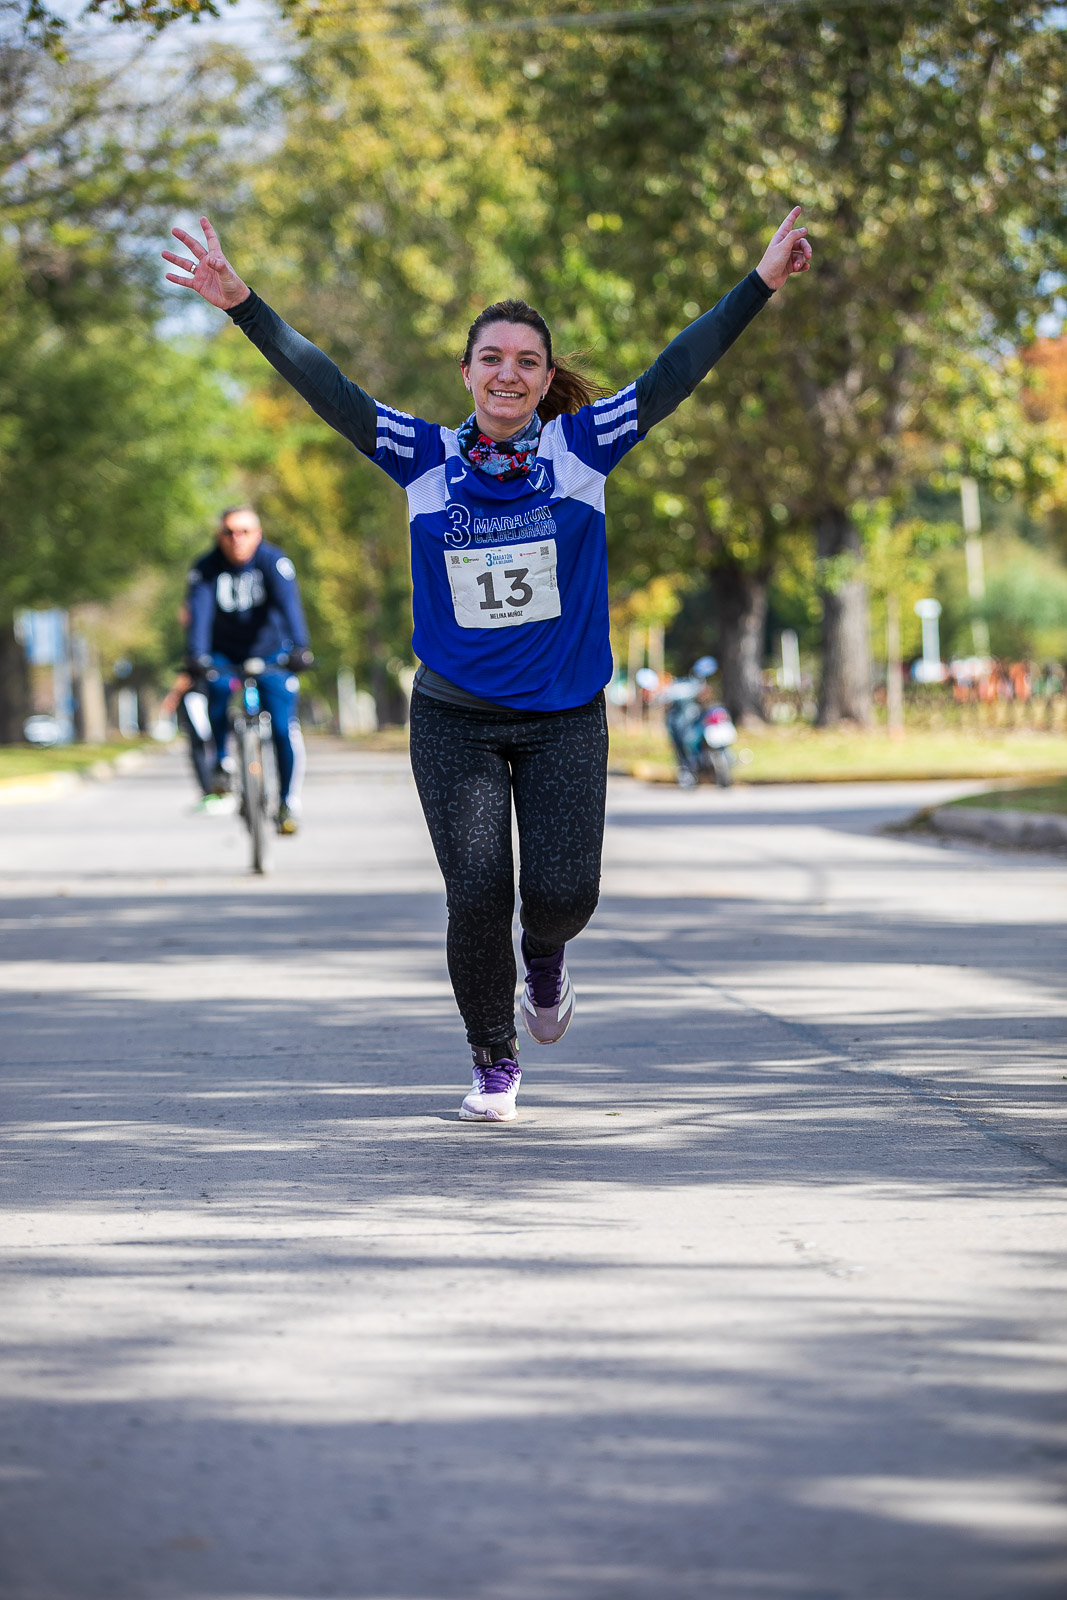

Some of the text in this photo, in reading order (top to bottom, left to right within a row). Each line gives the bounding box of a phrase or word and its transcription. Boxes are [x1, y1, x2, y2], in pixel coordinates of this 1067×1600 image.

[444, 503, 471, 549] 3
[485, 553, 493, 566] 3
[476, 568, 533, 610] 13
